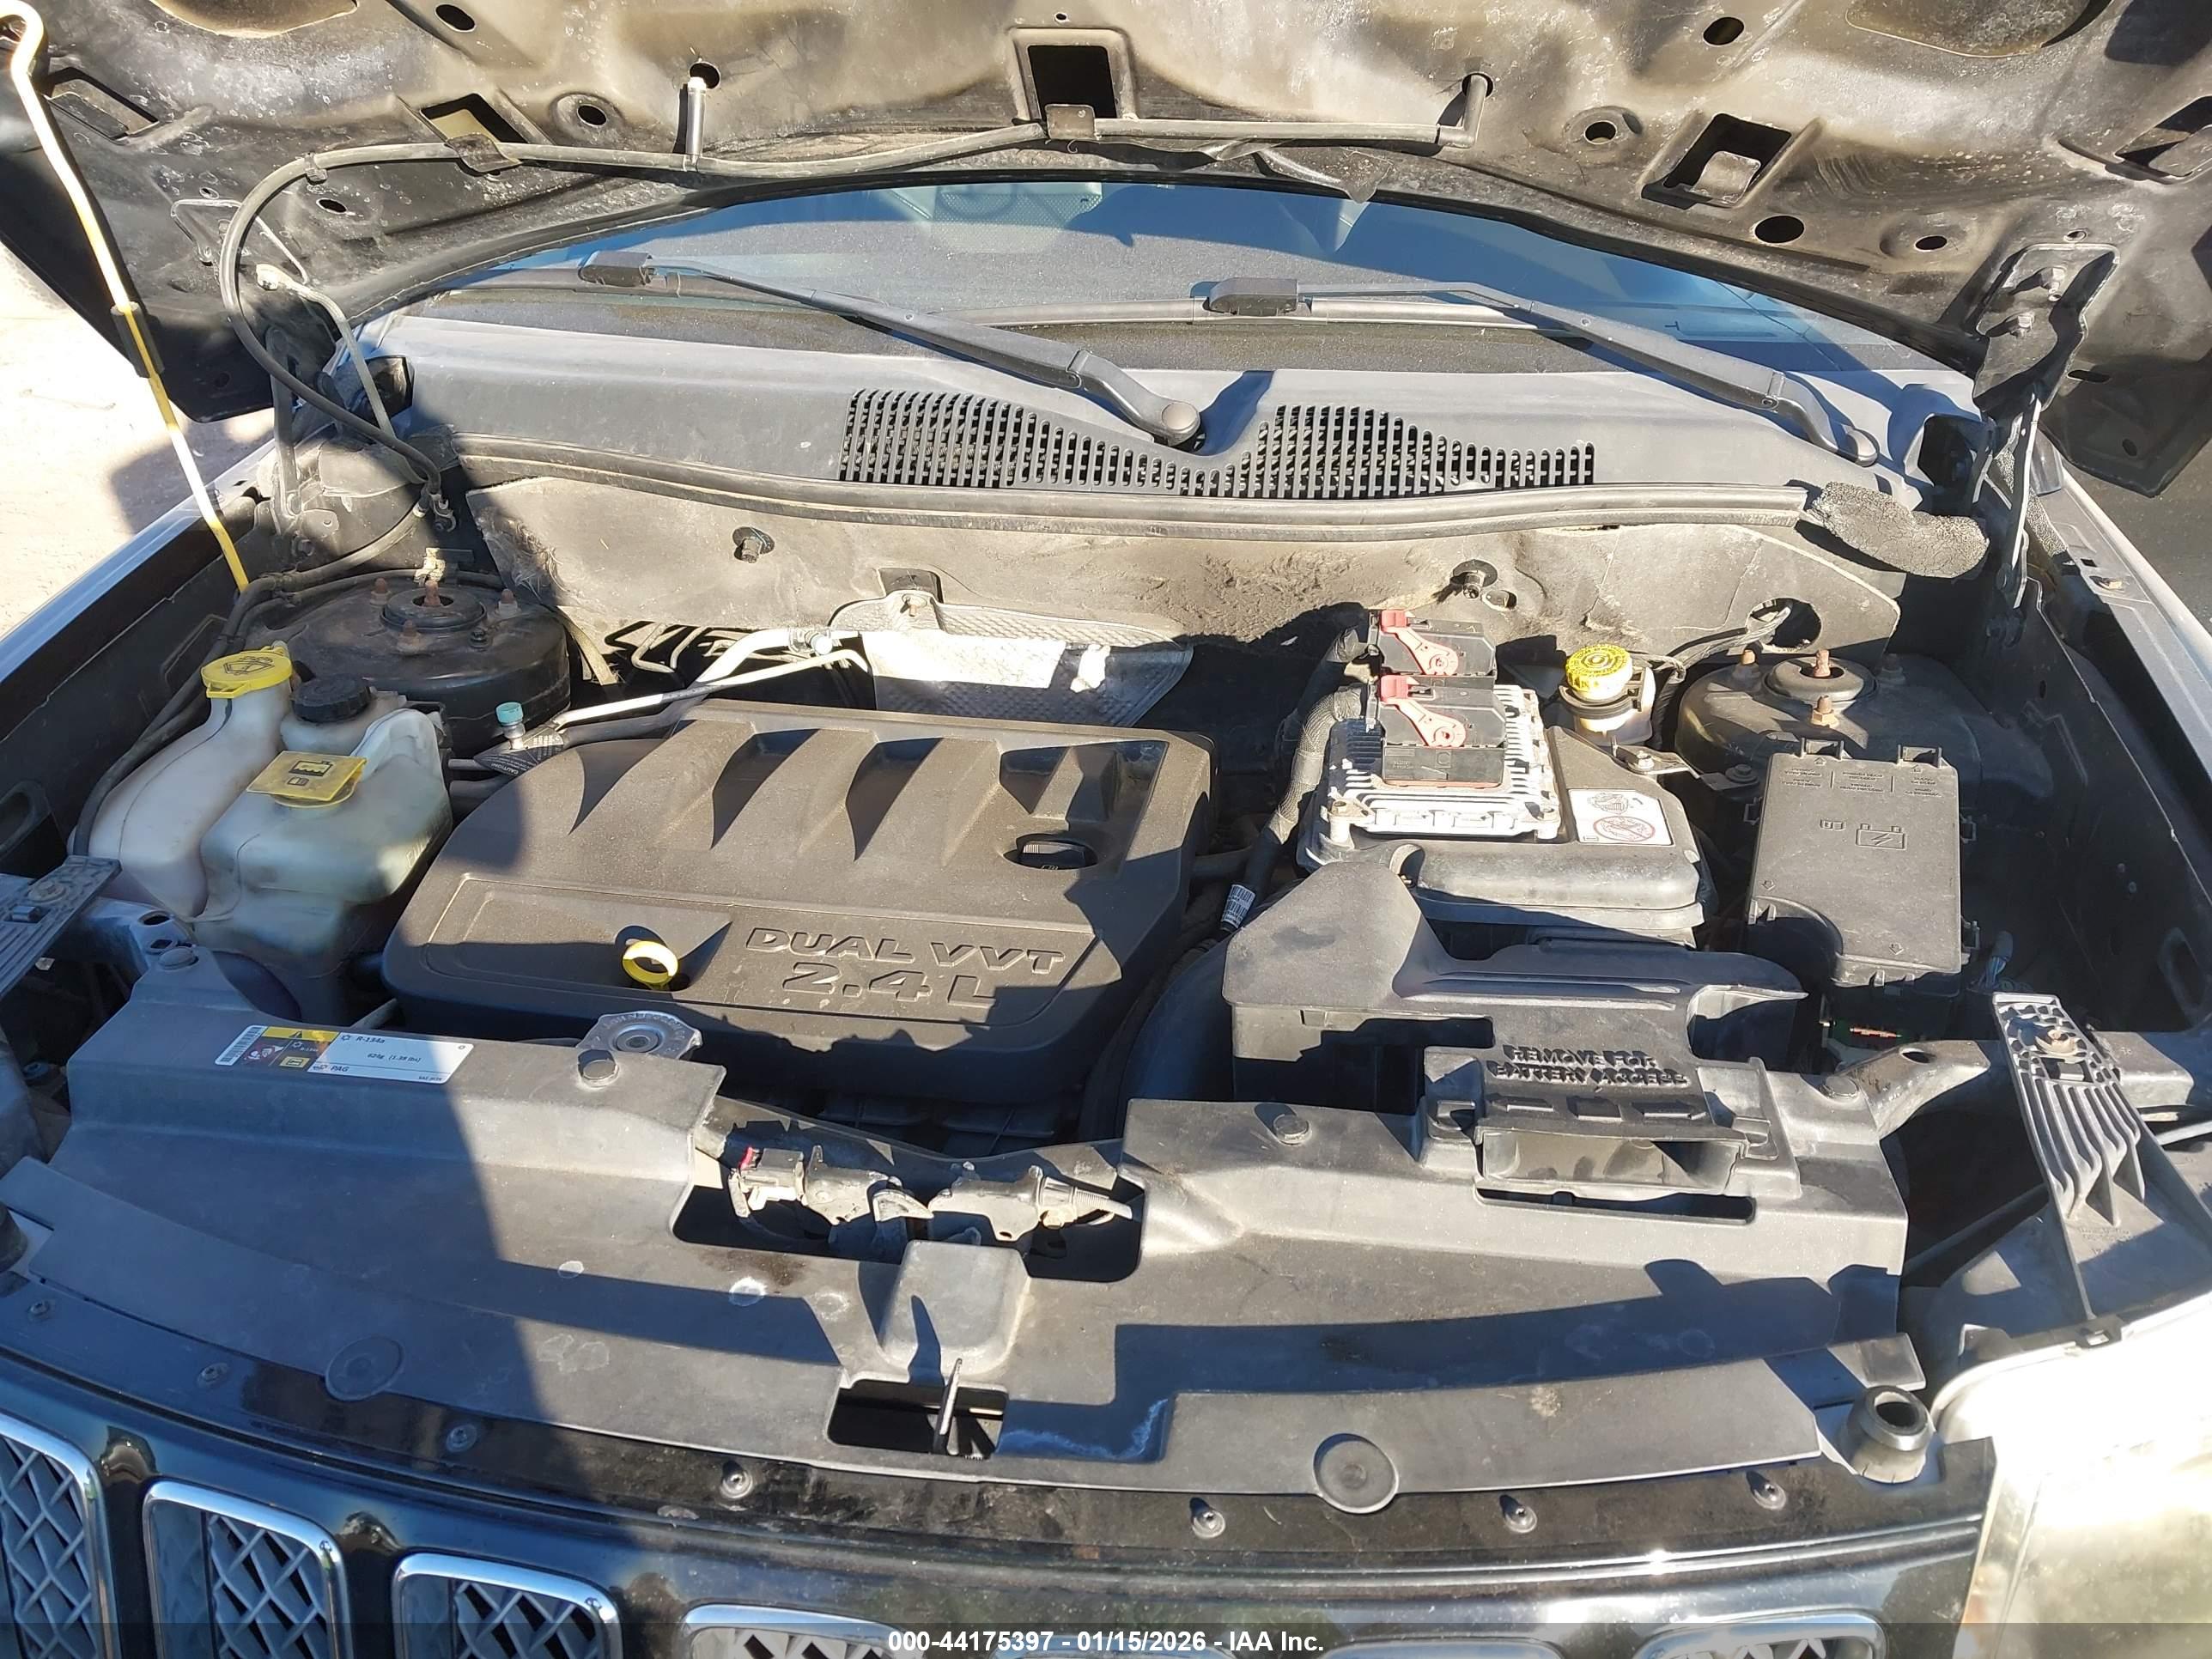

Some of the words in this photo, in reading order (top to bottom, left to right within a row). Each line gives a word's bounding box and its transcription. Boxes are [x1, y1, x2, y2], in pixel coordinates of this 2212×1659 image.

[745, 927, 915, 963] DUAL
[931, 942, 1065, 975] VVT
[356, 1036, 386, 1044] R-134a
[1504, 1044, 1606, 1066] REMOVE
[1604, 1050, 1659, 1070] FOR
[1486, 1060, 1588, 1085] BATTERY
[1590, 1067, 1691, 1088] ACCESS
